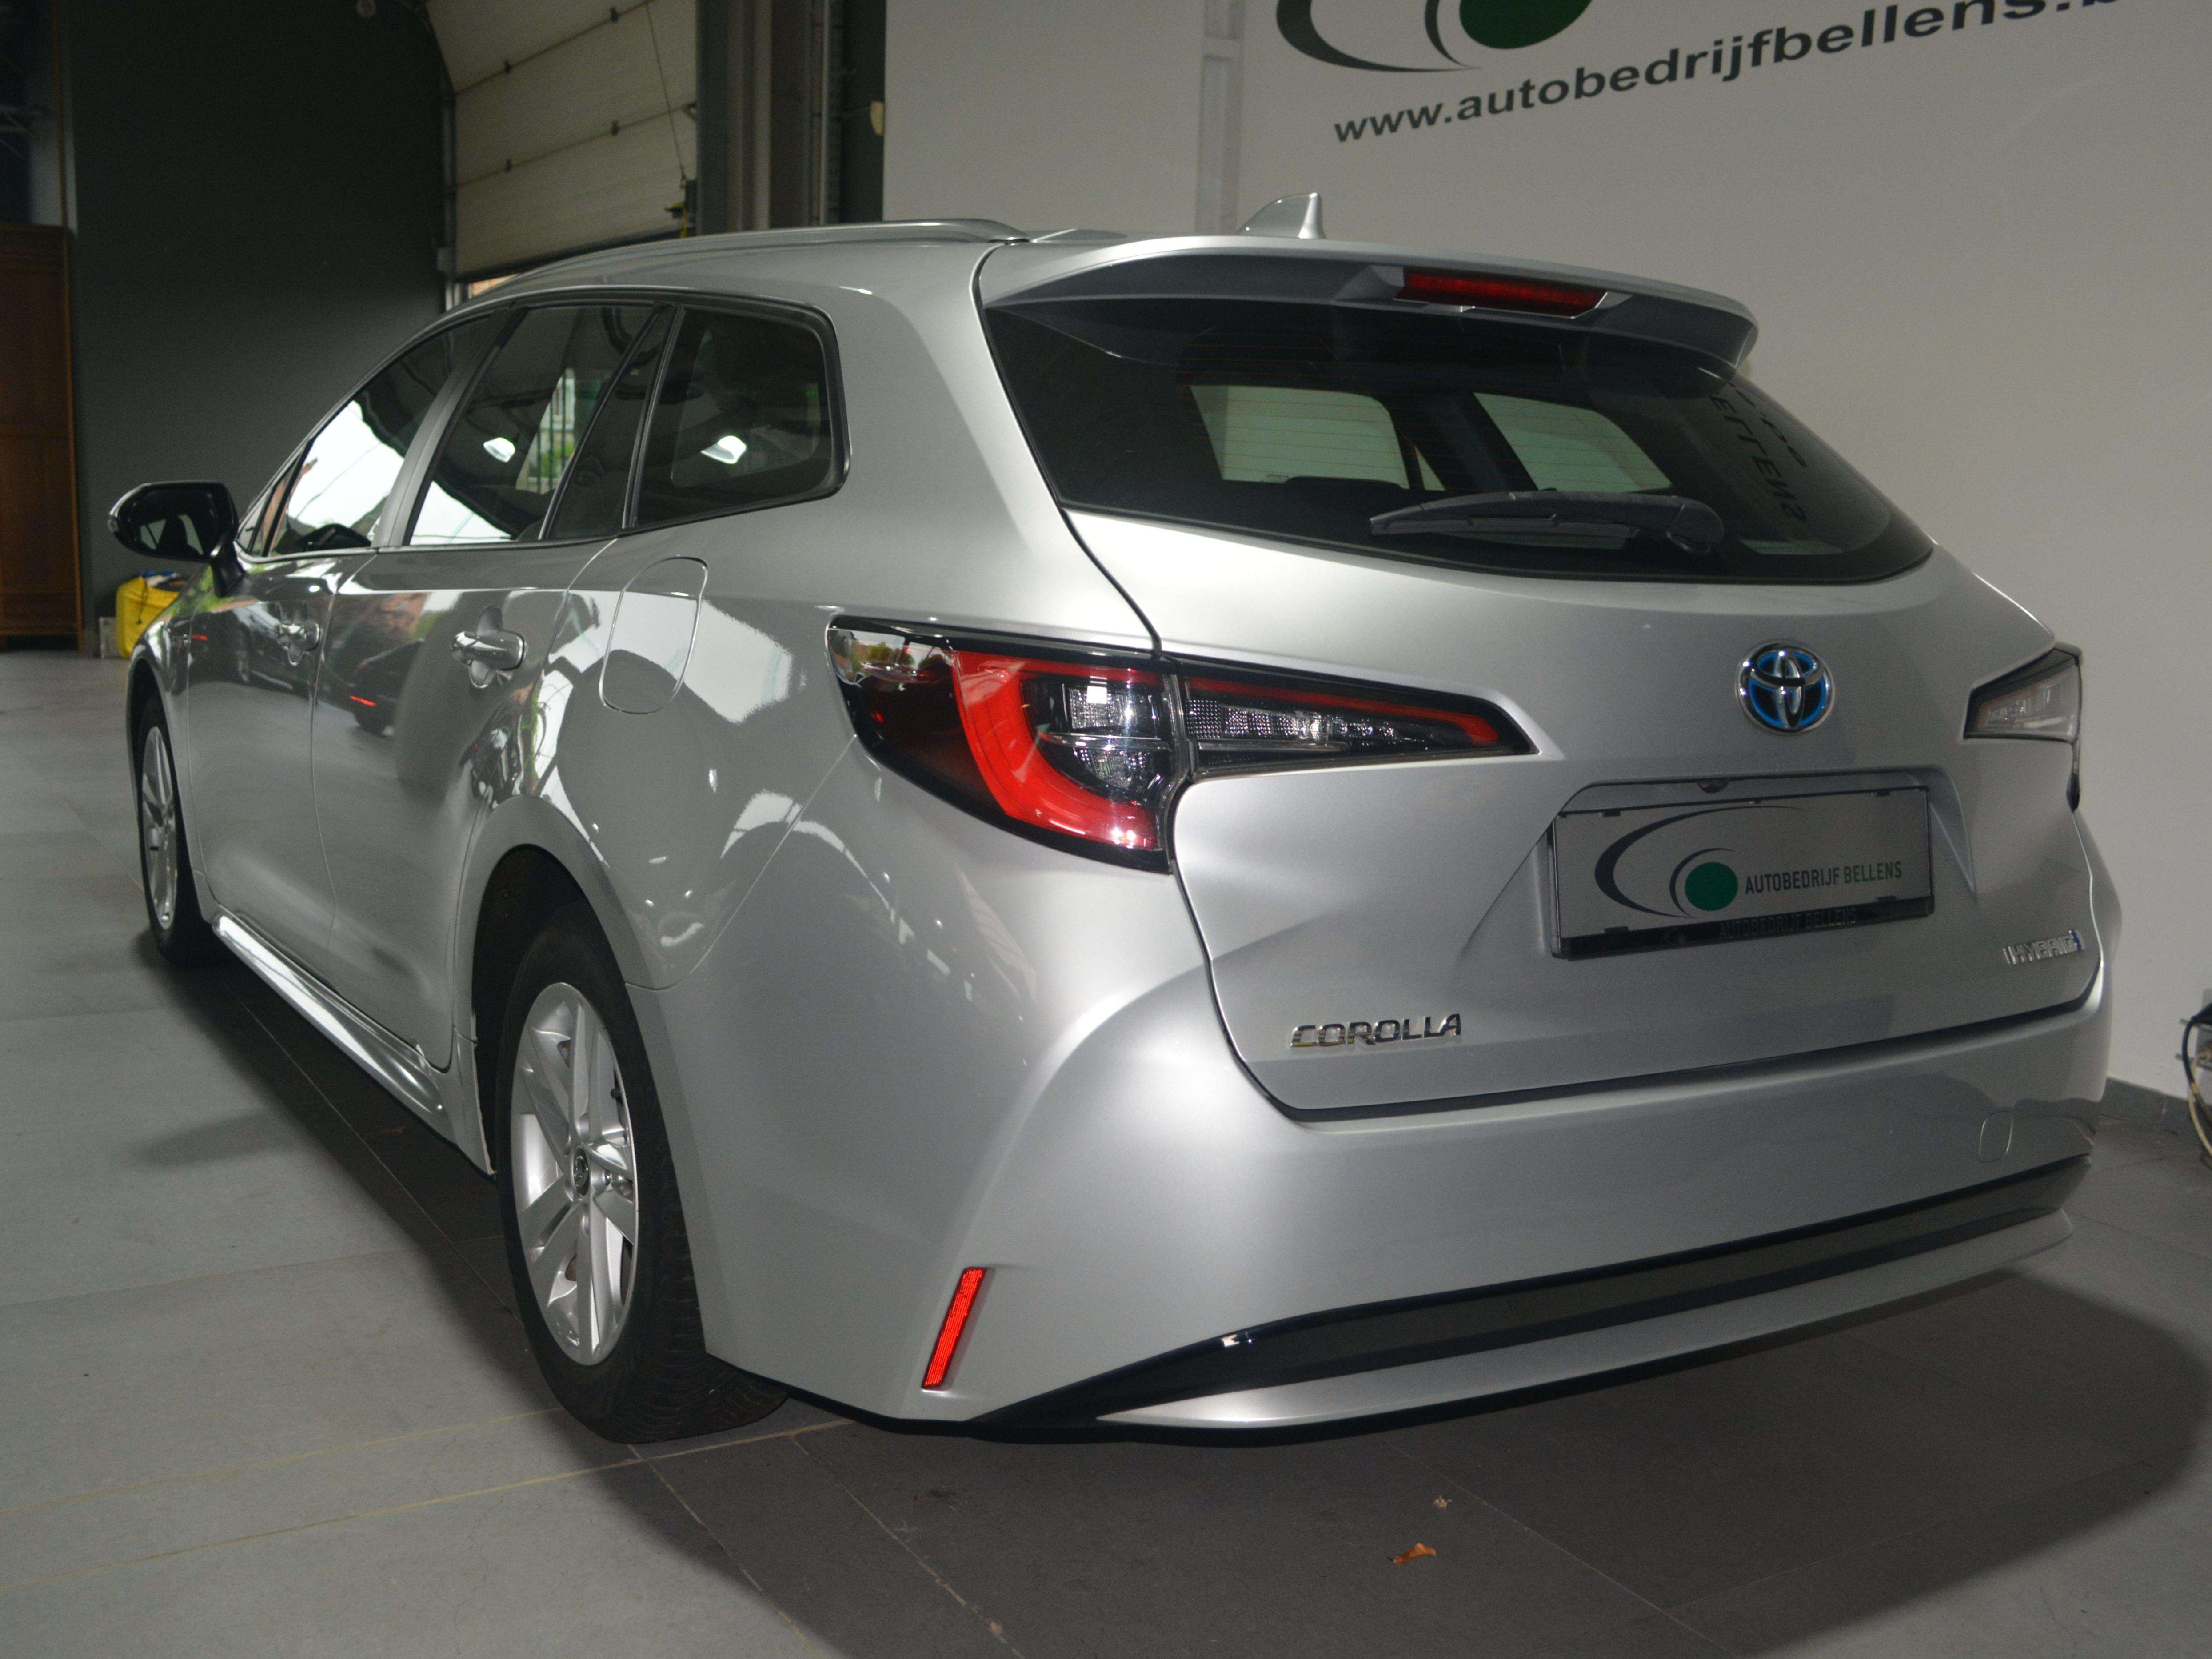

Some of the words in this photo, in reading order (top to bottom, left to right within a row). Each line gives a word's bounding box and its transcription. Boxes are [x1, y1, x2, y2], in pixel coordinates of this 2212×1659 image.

[1333, 0, 2120, 143] www.autobedrijfbellens.
[1745, 867, 1840, 895] AUTOBEDRIJF
[1844, 861, 1902, 885] BELLENS
[1719, 913, 1802, 940] AUTOBEDRIJF
[1805, 907, 1857, 929] BELLENS
[2003, 935, 2080, 965] HYBRID
[1289, 1013, 1462, 1048] COROLLA
